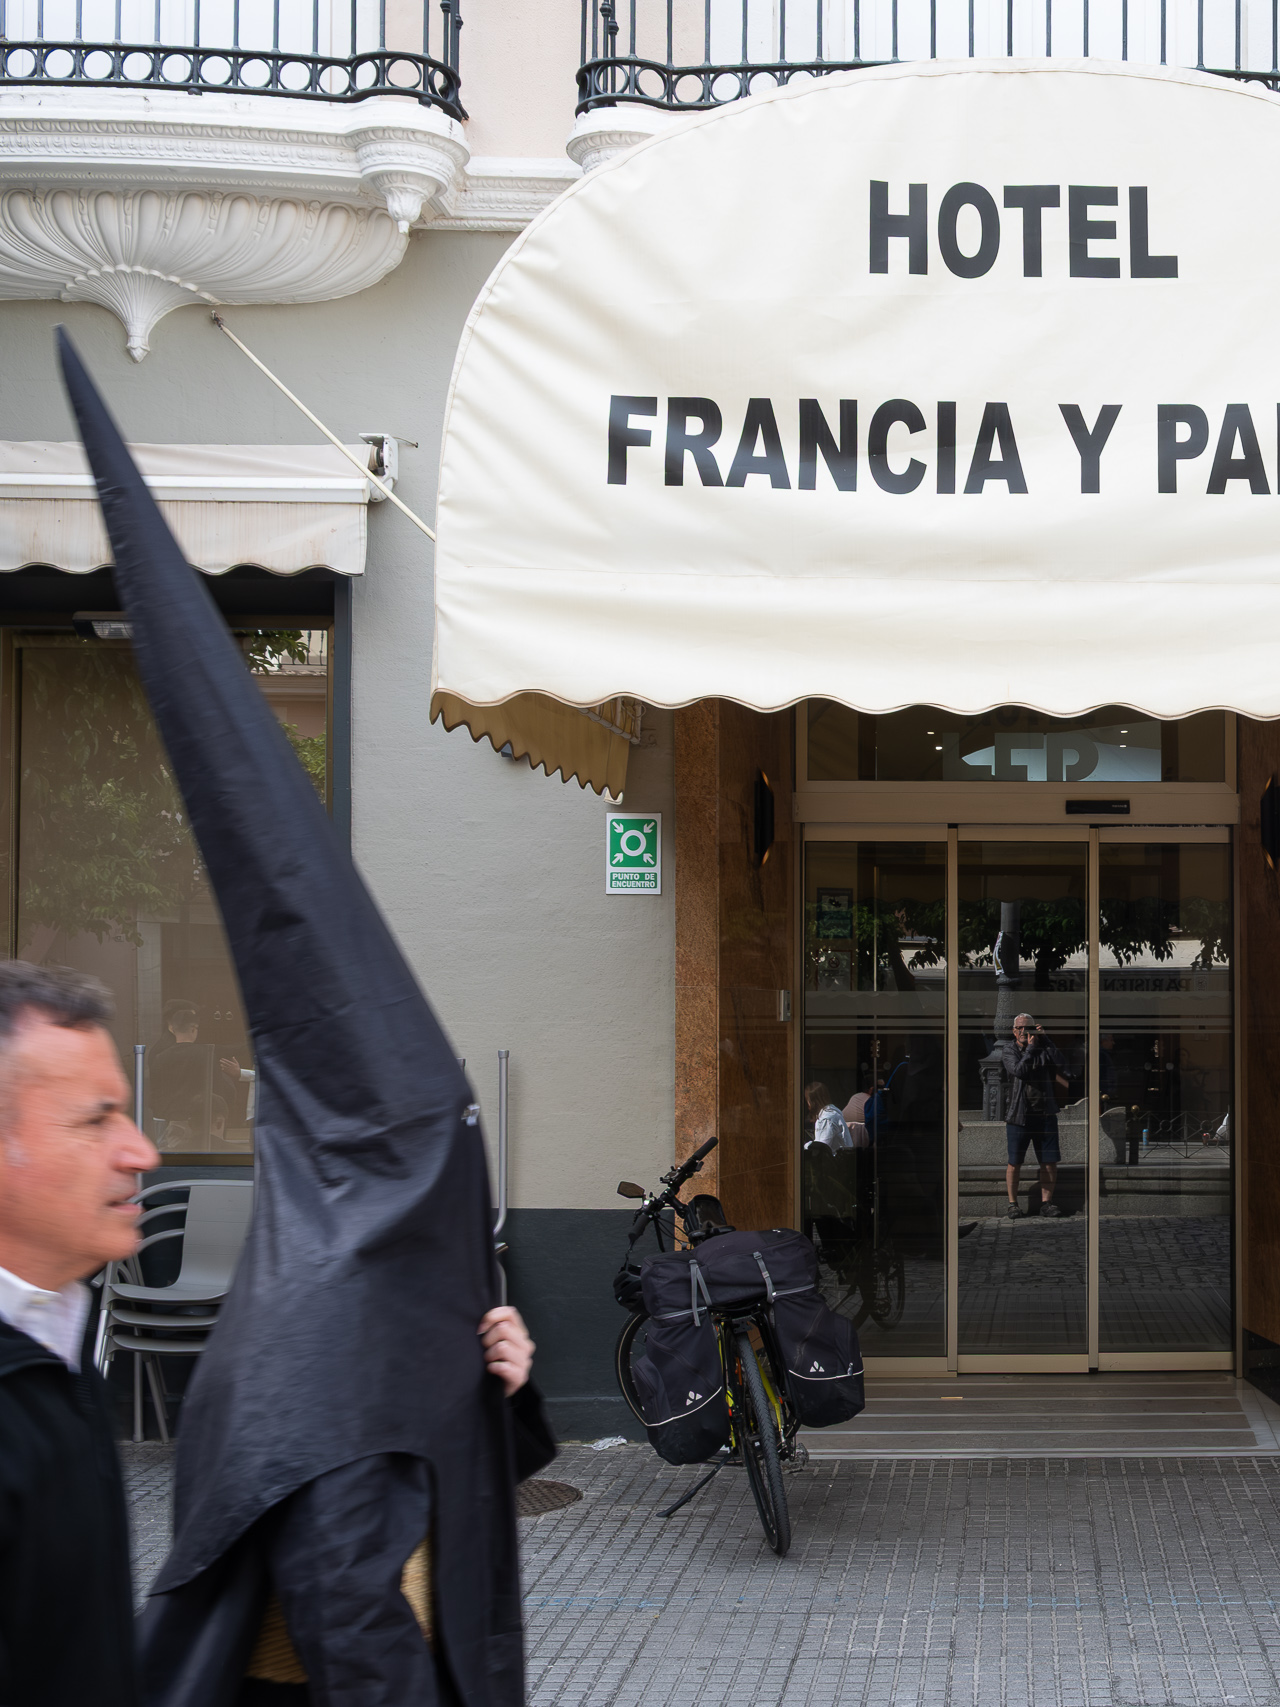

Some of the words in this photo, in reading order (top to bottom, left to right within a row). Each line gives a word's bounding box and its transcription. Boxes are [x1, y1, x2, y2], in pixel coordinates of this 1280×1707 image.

[868, 179, 1180, 280] HOTEL
[606, 394, 1029, 495] FRANCIA
[1058, 403, 1123, 494] Y
